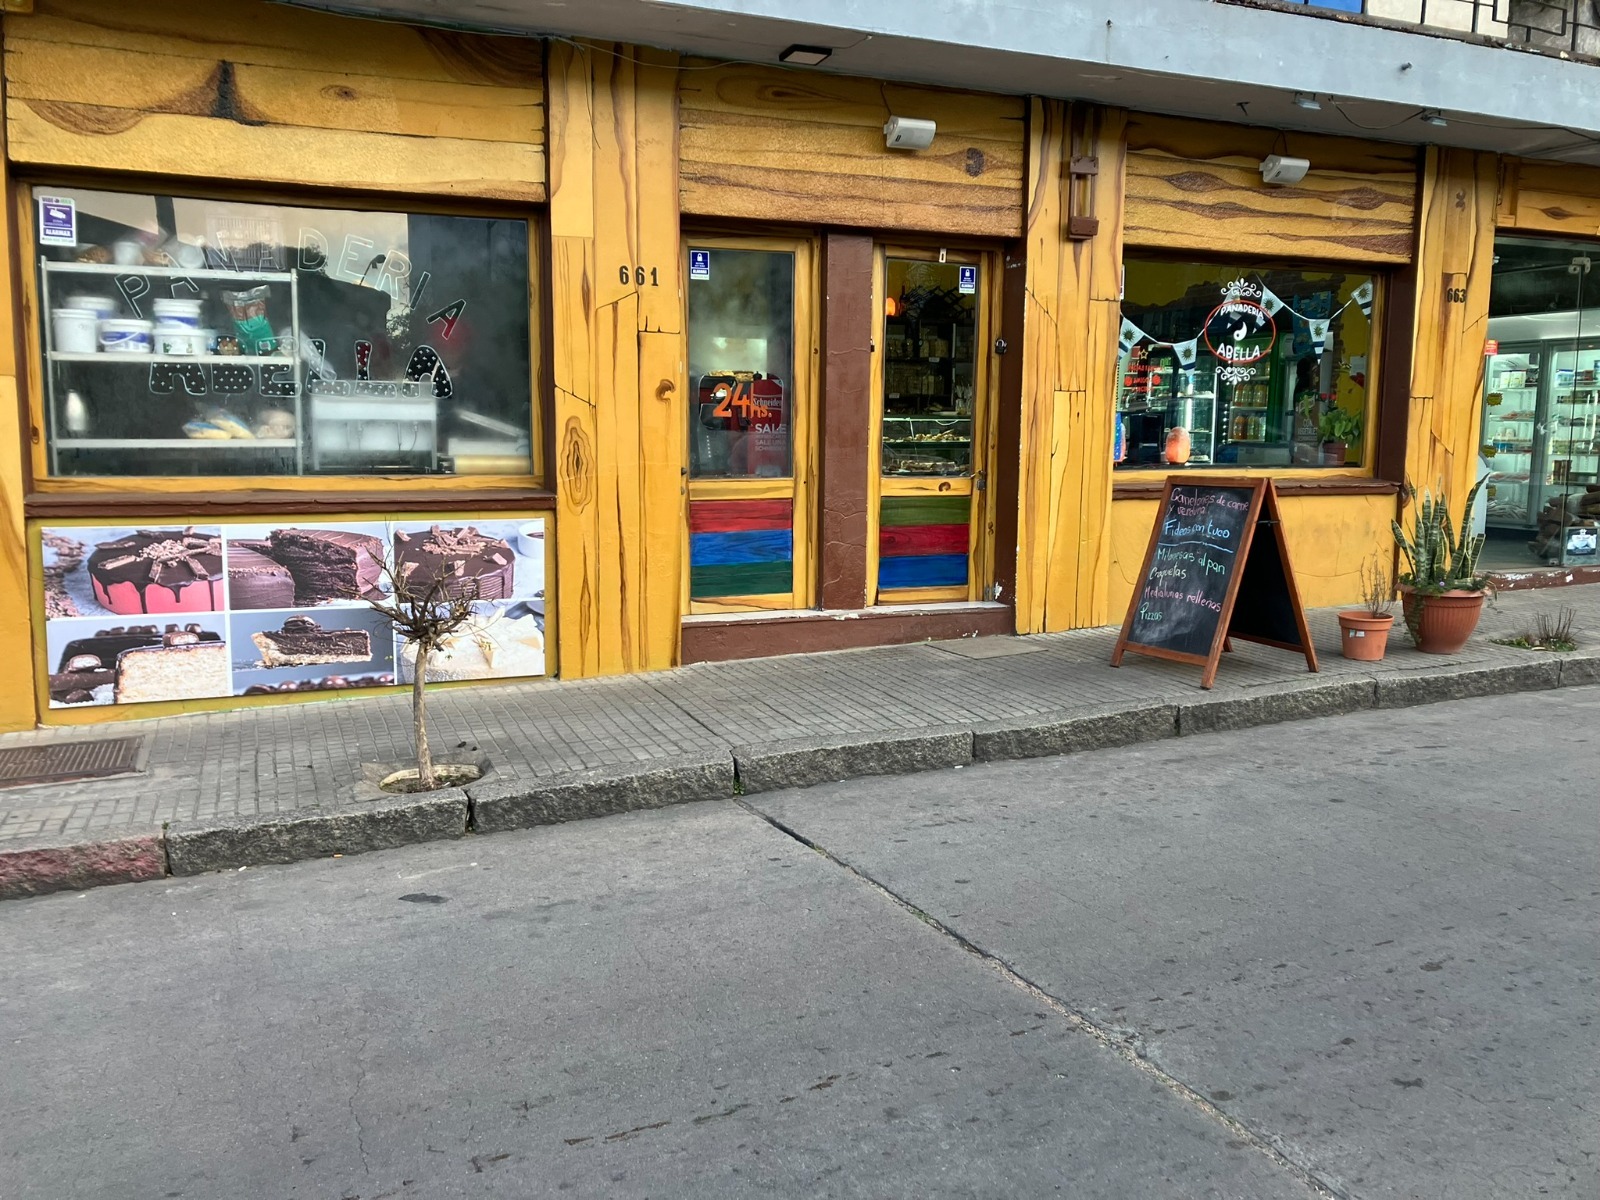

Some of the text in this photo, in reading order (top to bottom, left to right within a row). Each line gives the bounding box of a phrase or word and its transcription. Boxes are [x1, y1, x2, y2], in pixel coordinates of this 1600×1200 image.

[114, 227, 466, 340] PANADERIA
[619, 265, 659, 286] 661
[1447, 287, 1466, 303] 663
[1220, 303, 1264, 319] PANADERIA
[1217, 342, 1261, 361] ABELLA
[149, 335, 454, 399] ABELLA
[755, 423, 787, 434] SALE
[1216, 495, 1226, 507] de
[1226, 501, 1249, 511] carne
[1164, 518, 1191, 537] Fideos
[1206, 519, 1231, 538] tuco
[1197, 552, 1207, 567] al
[1205, 558, 1226, 576] pan
[1140, 602, 1164, 620] Pizzas
